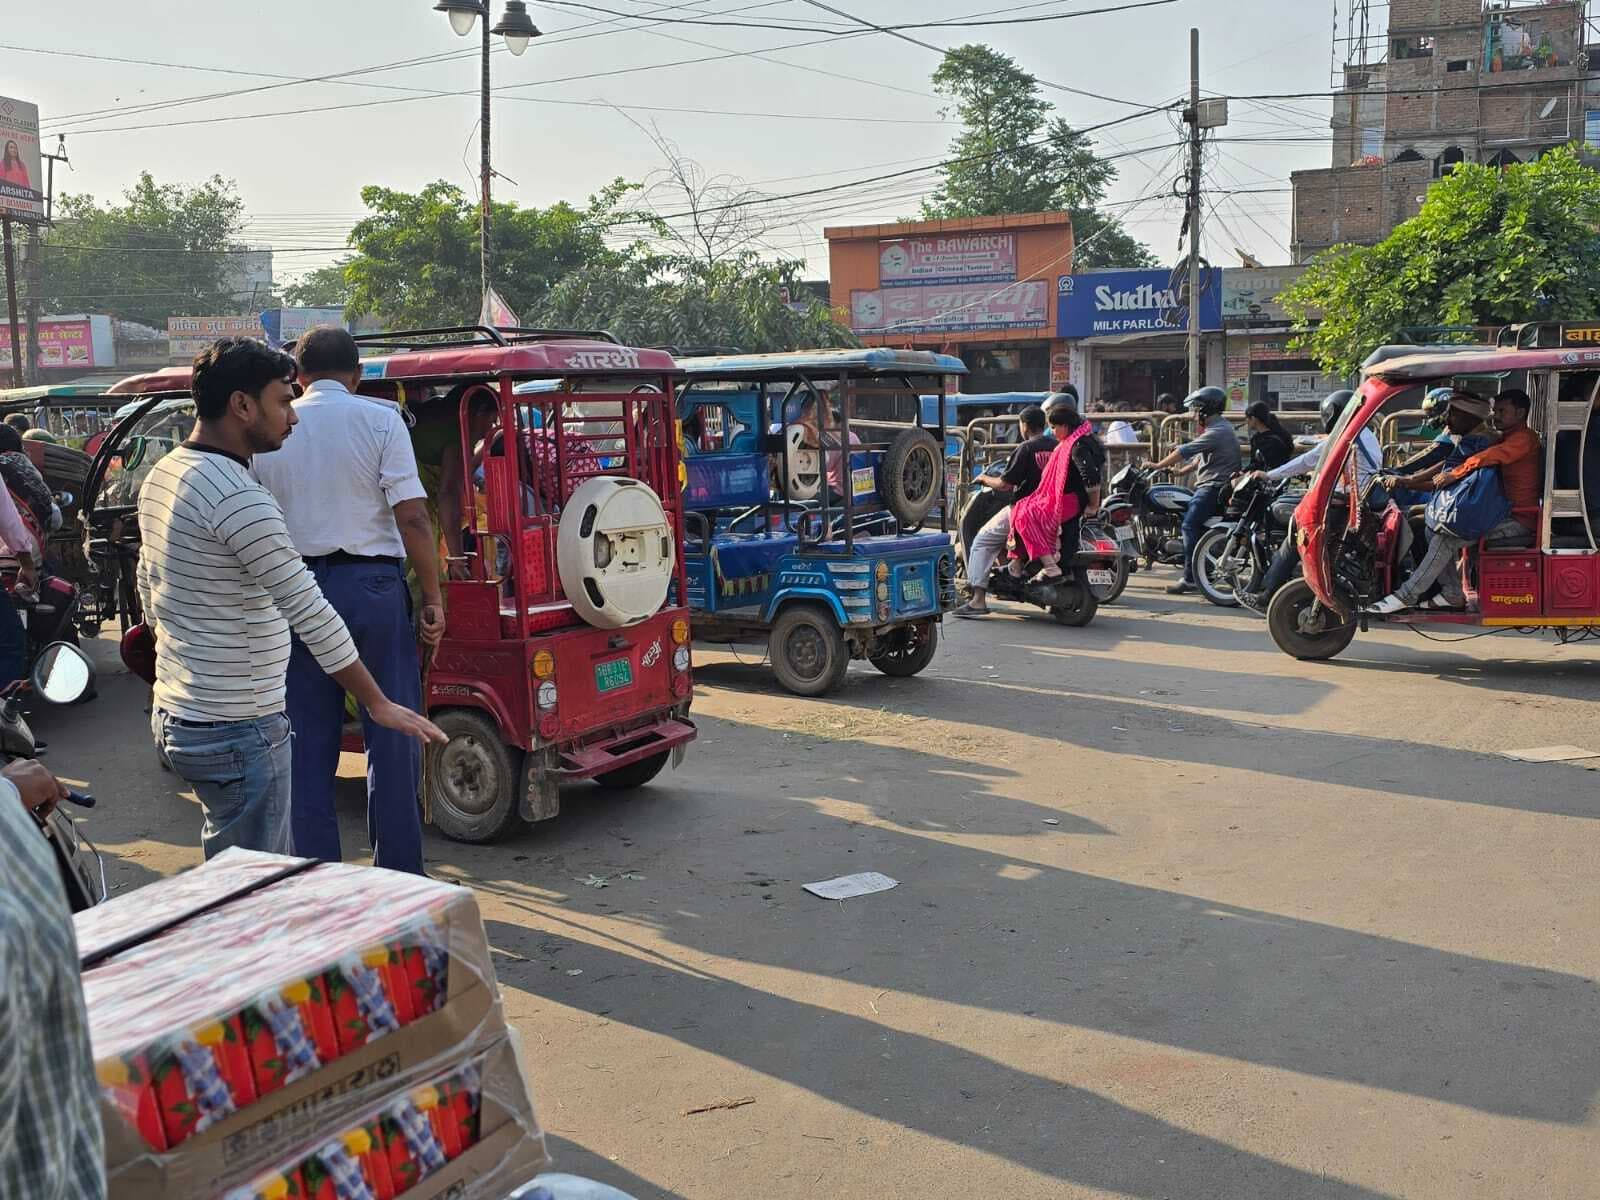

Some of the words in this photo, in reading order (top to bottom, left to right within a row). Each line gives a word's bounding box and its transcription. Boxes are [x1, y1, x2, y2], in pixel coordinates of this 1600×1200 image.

[0, 185, 34, 199] ARSHITA
[909, 240, 933, 260] The
[937, 234, 1013, 256] BAWARCHI
[1095, 283, 1178, 311] Sudha
[1093, 320, 1121, 331] MILK
